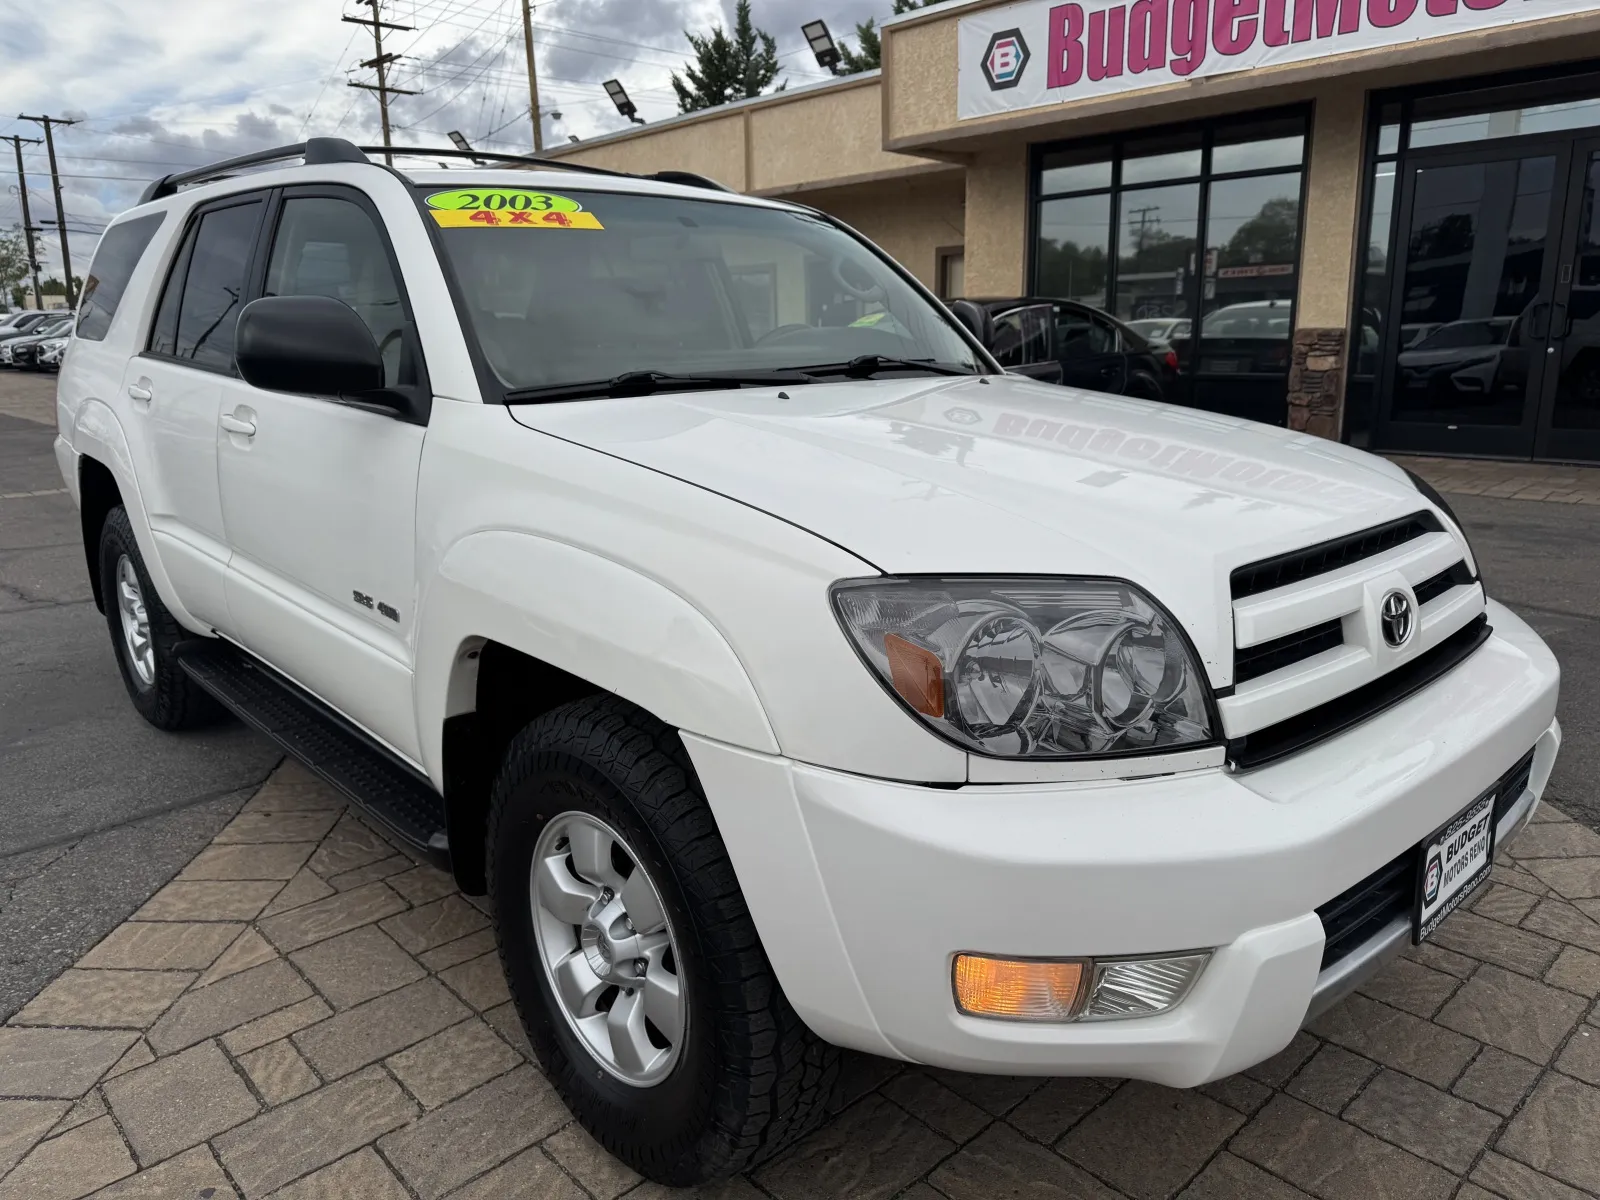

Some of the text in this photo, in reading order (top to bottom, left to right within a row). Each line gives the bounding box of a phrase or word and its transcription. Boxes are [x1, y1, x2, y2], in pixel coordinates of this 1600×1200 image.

[1046, 0, 1531, 90] BudgetM
[457, 194, 554, 211] 2003
[1443, 835, 1486, 889] MOTORS RENO
[1445, 811, 1490, 864] BUDGET
[1419, 864, 1492, 941] BudgetMotorsReno.com
